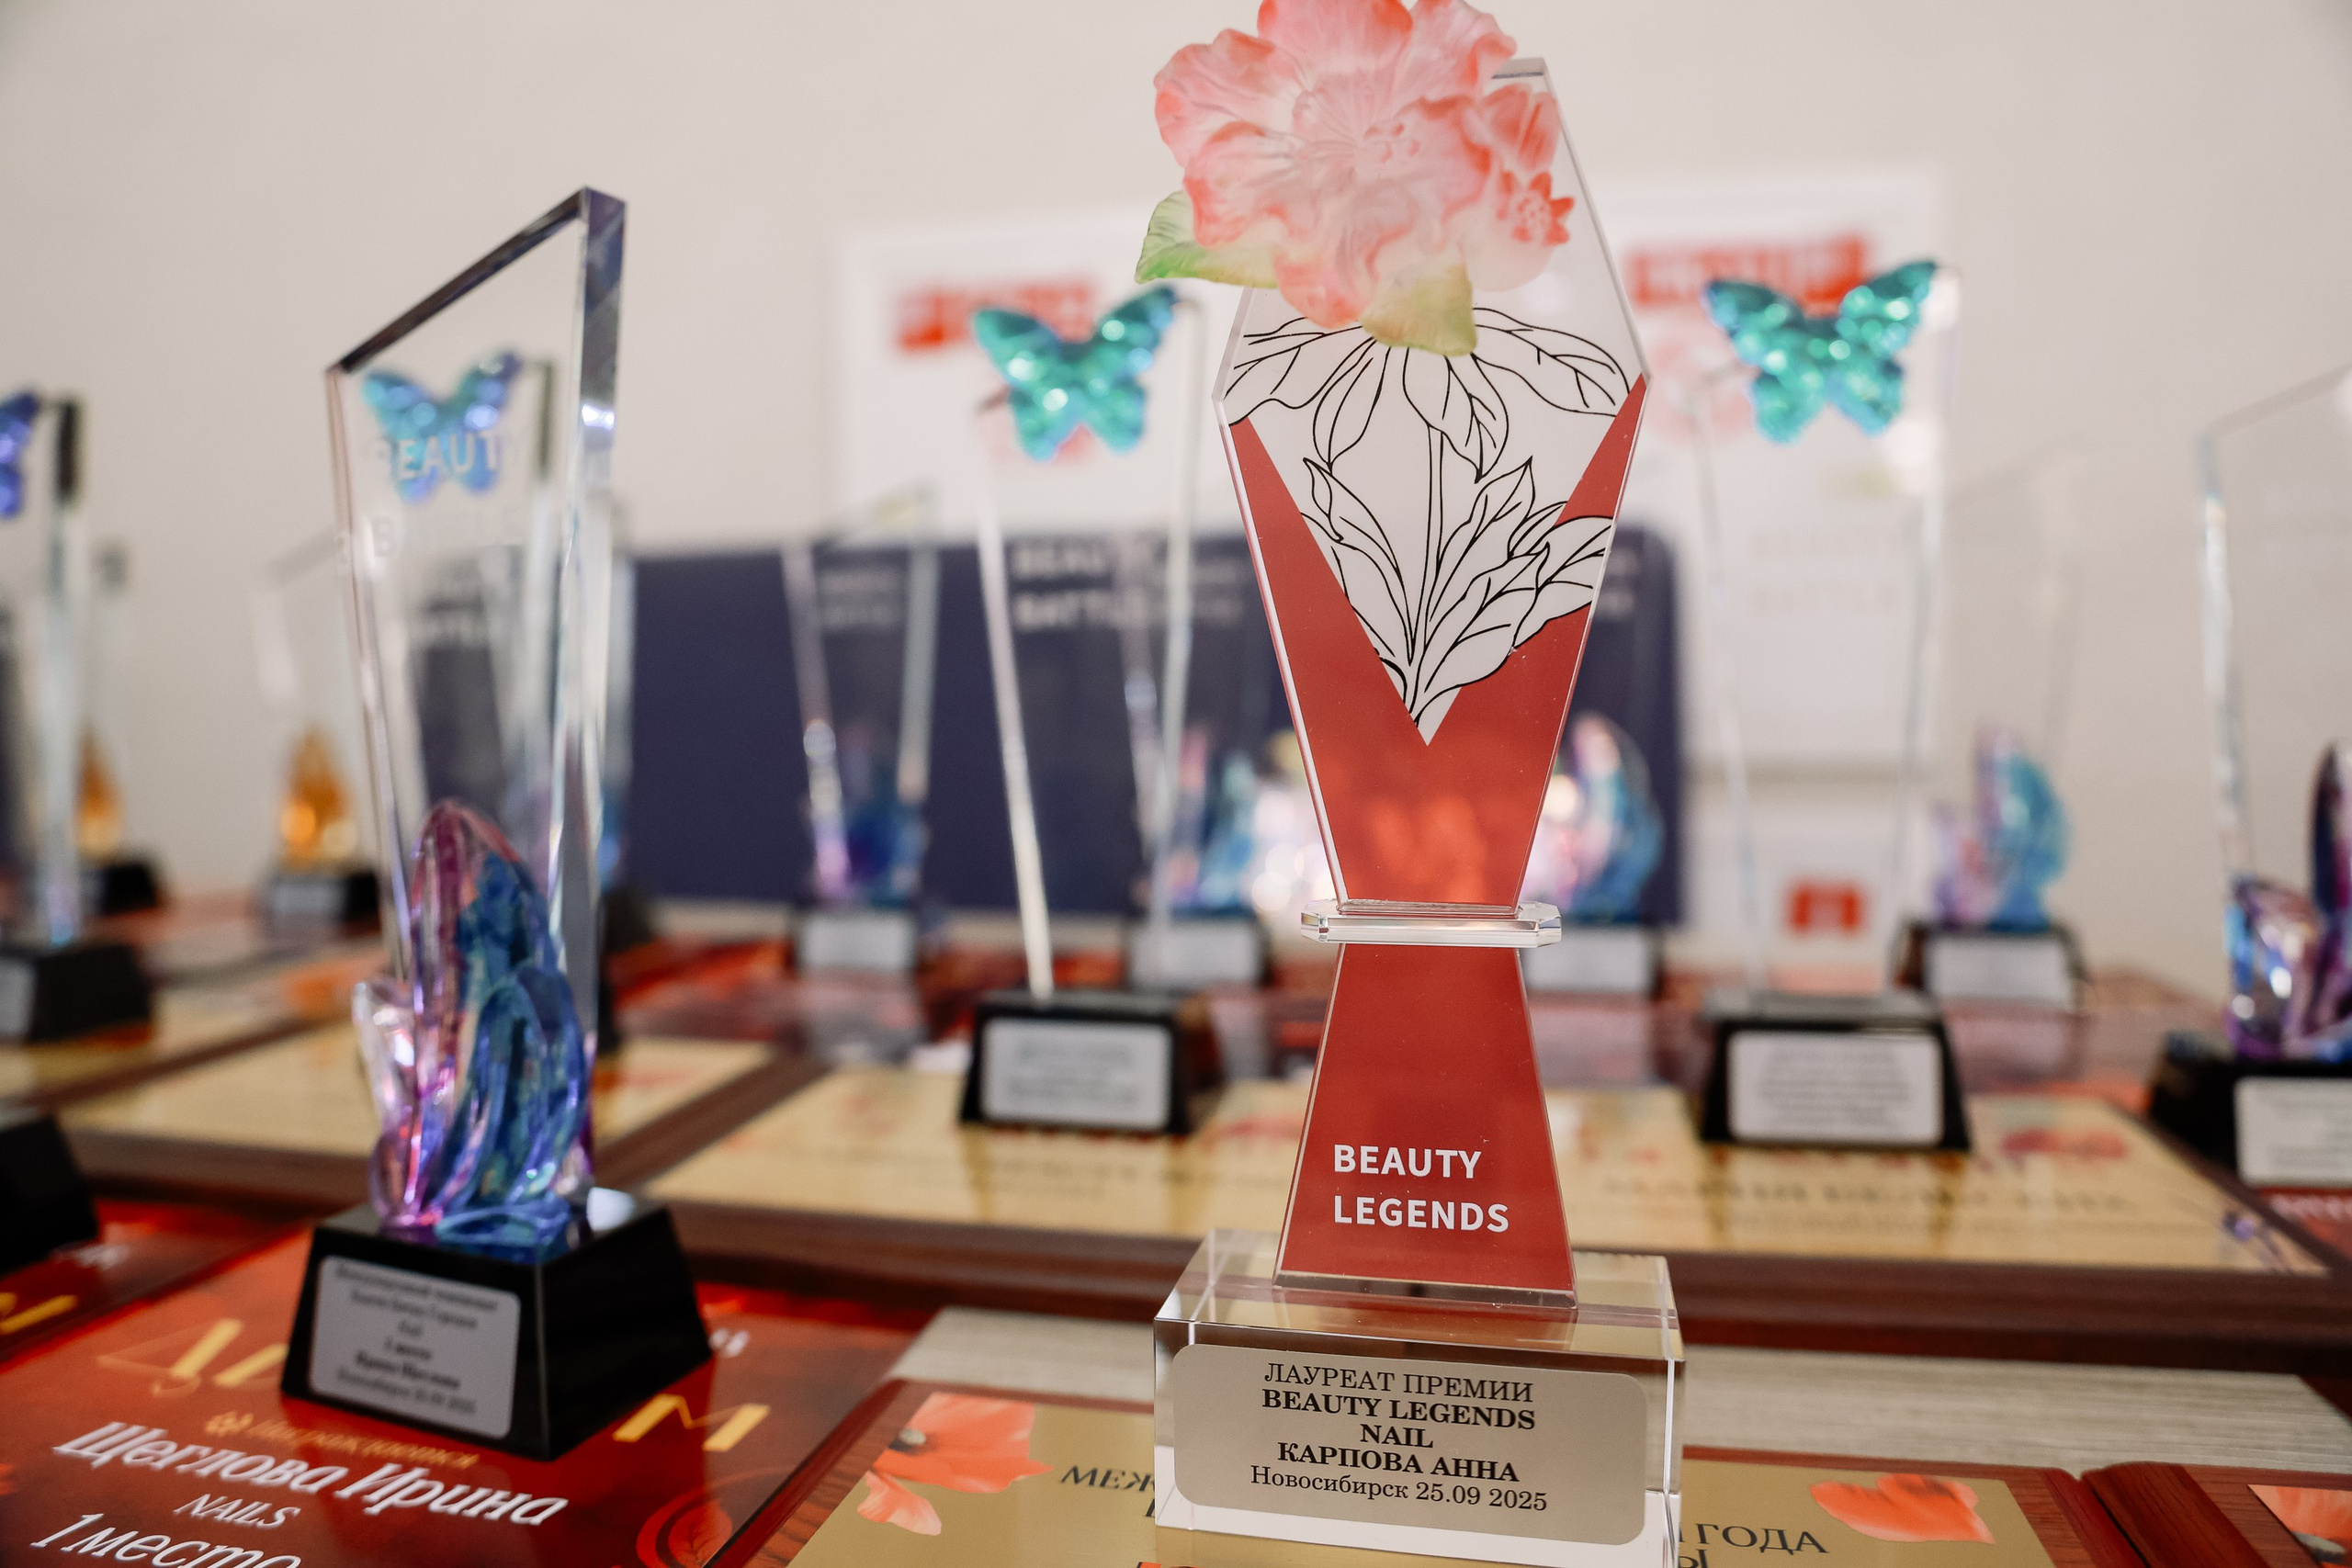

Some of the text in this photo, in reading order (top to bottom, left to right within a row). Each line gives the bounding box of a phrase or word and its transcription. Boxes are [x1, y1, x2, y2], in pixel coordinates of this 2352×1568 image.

[1334, 1144, 1482, 1179] BEAUTY
[1334, 1195, 1510, 1233] LEGENDS
[1264, 1362, 1533, 1403] ЛАУРЕАТ ПРЕМИИ
[1261, 1388, 1535, 1430] BEAUTY LEGENDS
[1360, 1423, 1434, 1449] NAIL
[52, 1421, 569, 1526] Щеглова Ирина
[1277, 1441, 1520, 1483] КАРПОВА АННА
[1250, 1464, 1547, 1512] Новосибирск 25.09 2025
[173, 1493, 301, 1529] NAILS
[29, 1512, 105, 1549] 1
[1696, 1523, 1829, 1555] ГОДА
